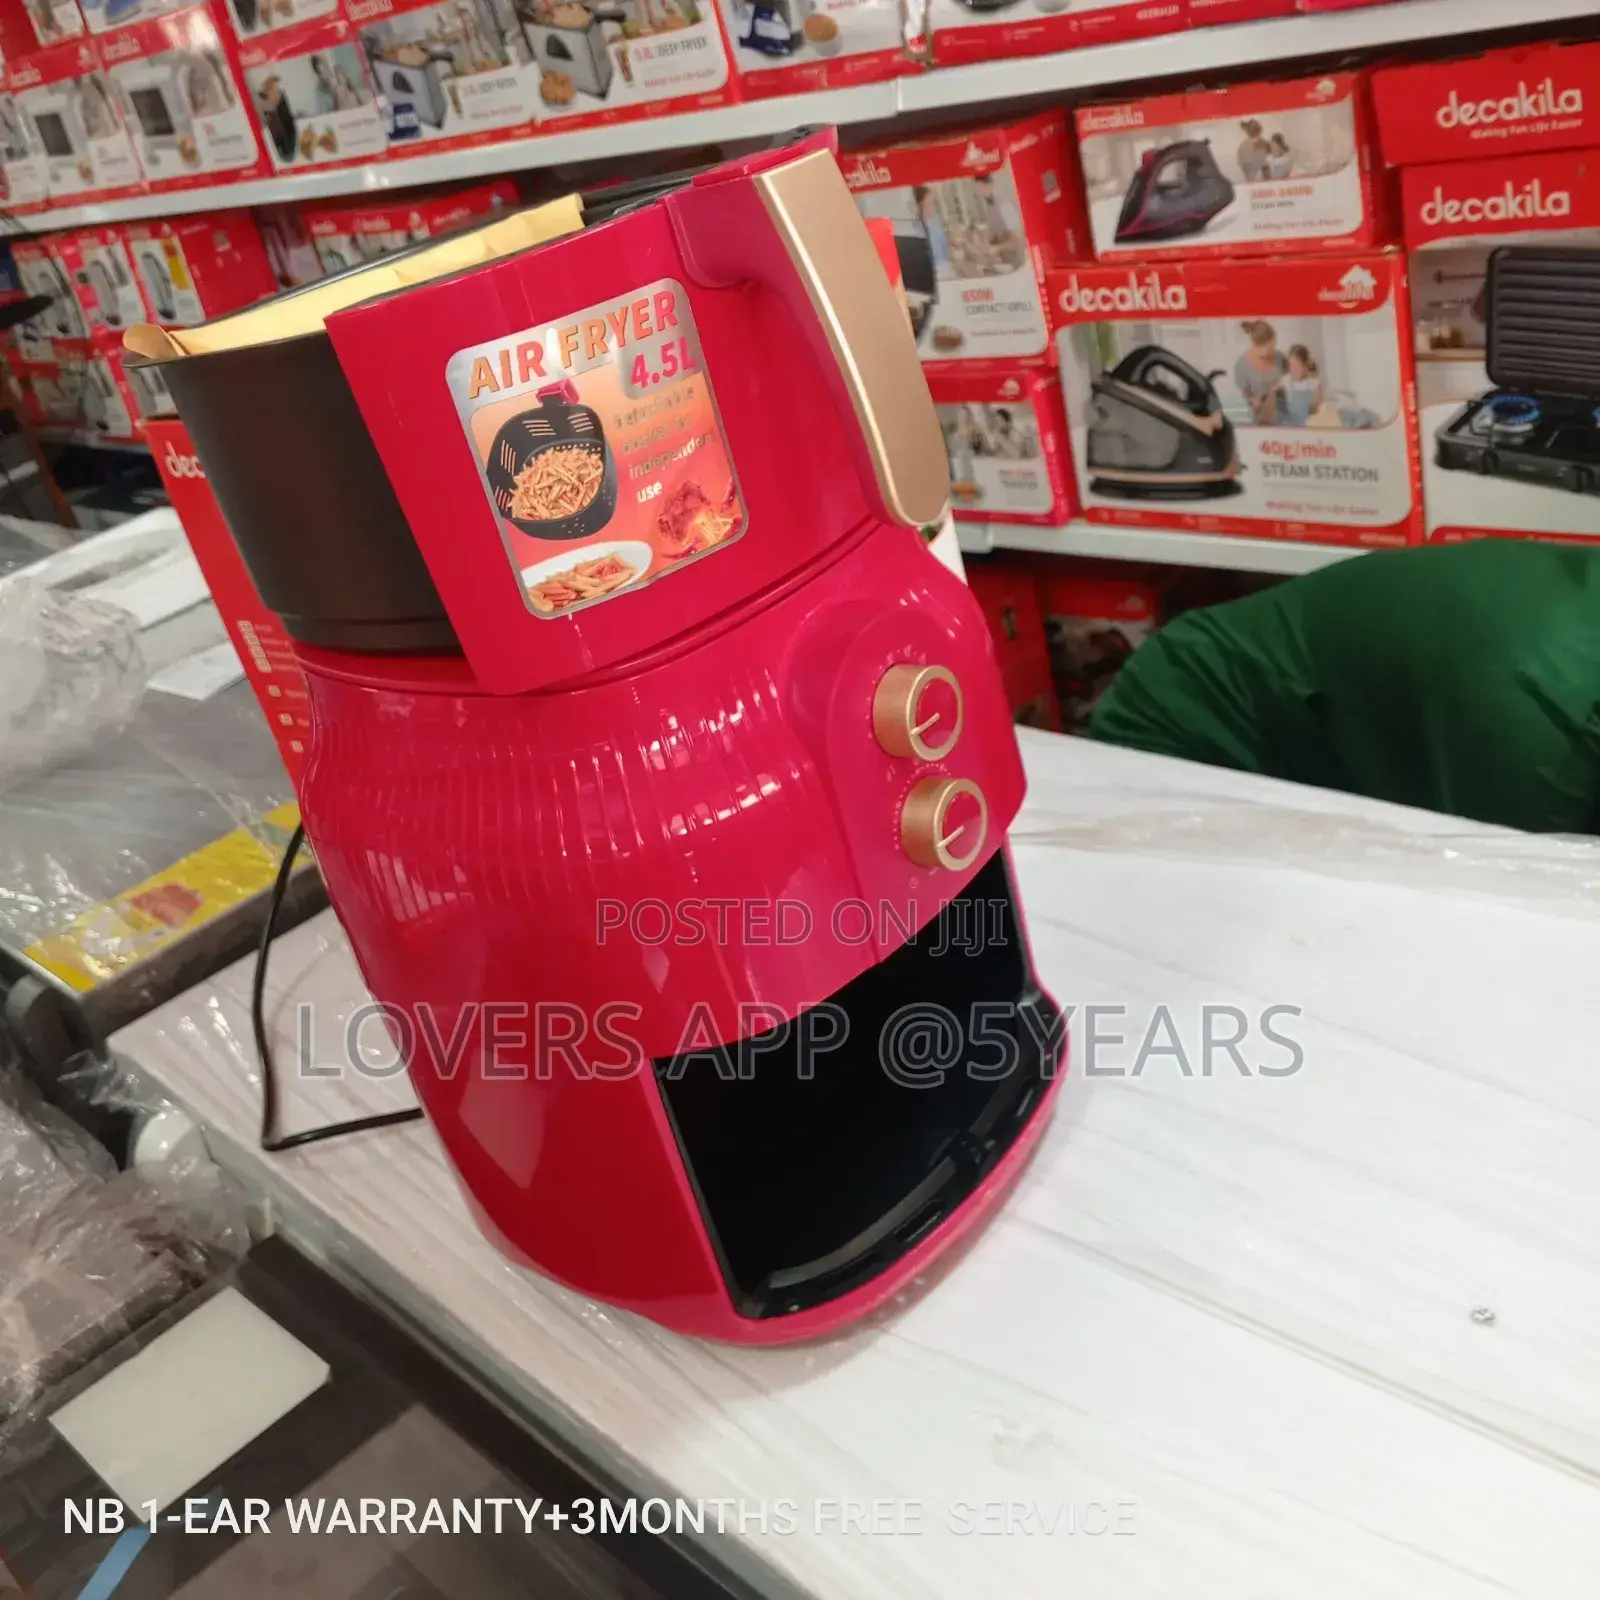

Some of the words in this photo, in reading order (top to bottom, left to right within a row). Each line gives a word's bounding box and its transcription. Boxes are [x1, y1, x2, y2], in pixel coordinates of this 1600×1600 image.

[1437, 77, 1583, 129] decakila
[1420, 178, 1571, 226] decakila
[1059, 271, 1187, 313] decakila
[469, 341, 548, 399] AIR
[558, 291, 678, 369] FRYER
[630, 338, 697, 388] 4.5L
[1259, 439, 1337, 462] 40g/min
[1261, 462, 1310, 478] STEAM
[1313, 464, 1380, 482] STATION
[636, 481, 663, 503] use
